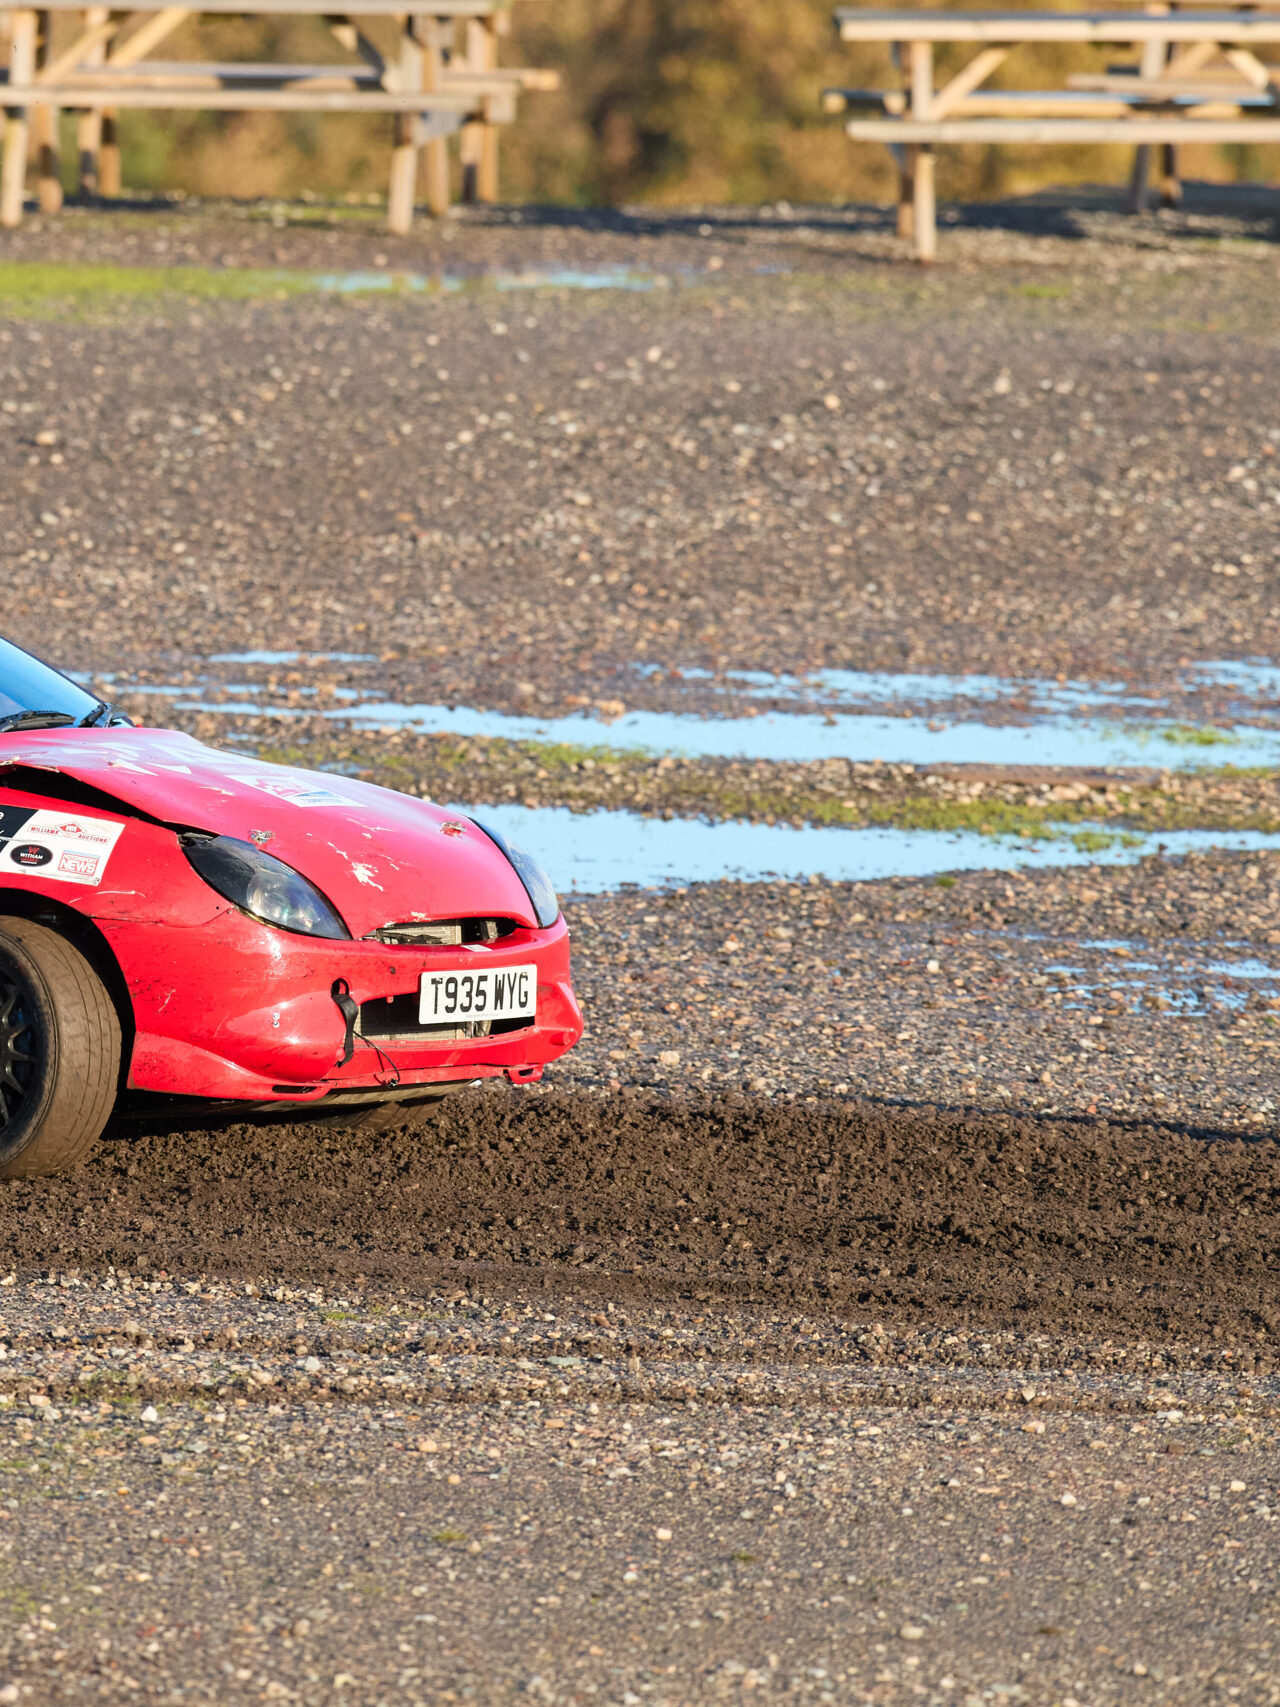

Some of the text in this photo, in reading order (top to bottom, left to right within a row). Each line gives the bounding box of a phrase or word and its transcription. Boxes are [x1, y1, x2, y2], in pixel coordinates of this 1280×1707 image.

[30, 826, 59, 835] WILLIAMS
[78, 834, 108, 843] AUCTIONS
[20, 852, 44, 860] WITHAM
[60, 857, 96, 874] NEWS
[430, 972, 529, 1014] T935 WYG
